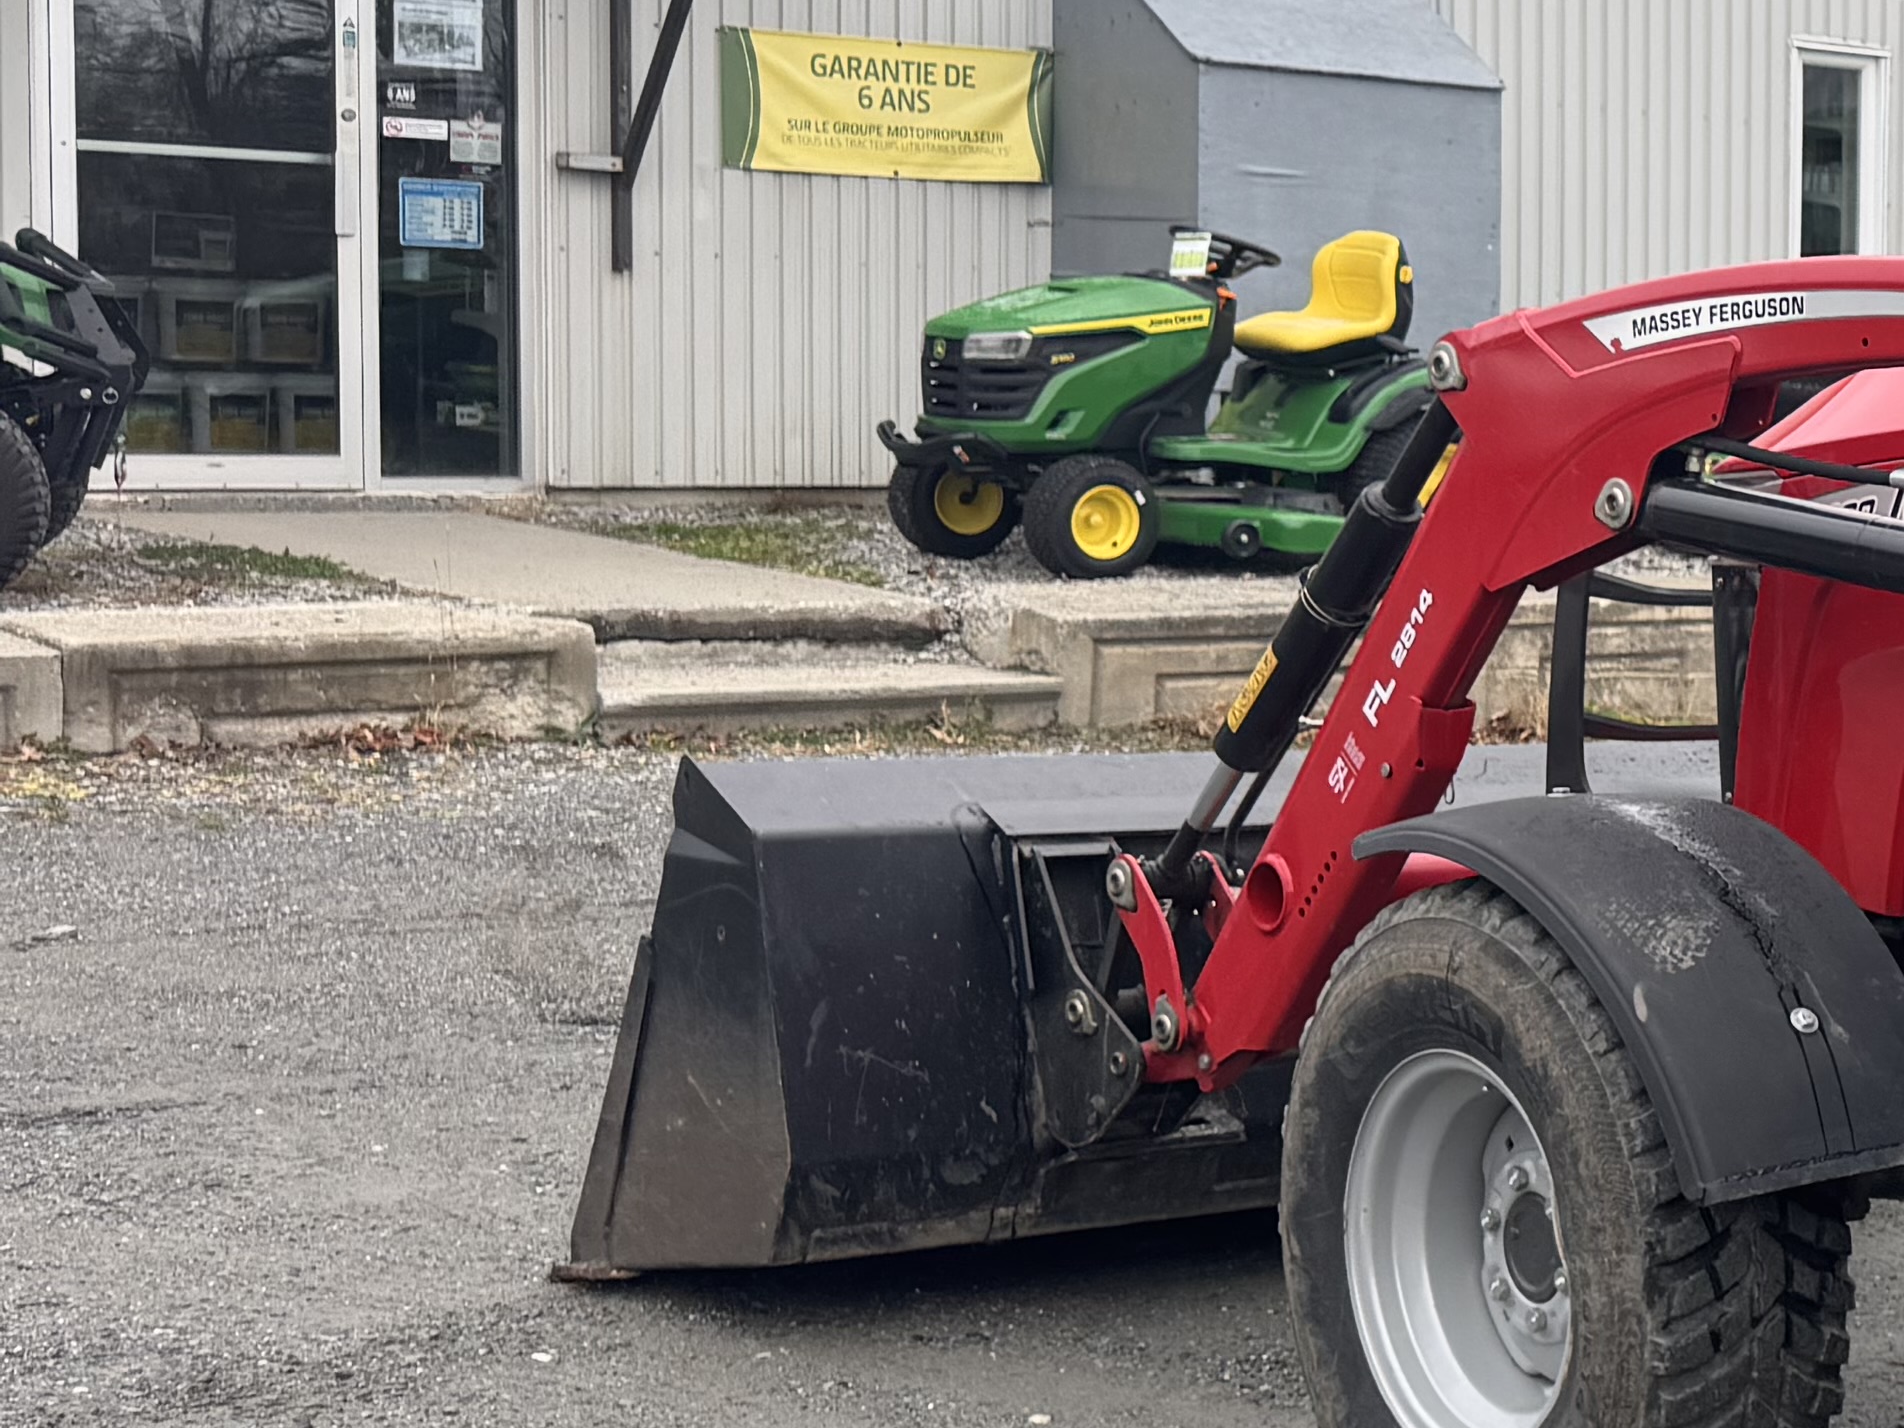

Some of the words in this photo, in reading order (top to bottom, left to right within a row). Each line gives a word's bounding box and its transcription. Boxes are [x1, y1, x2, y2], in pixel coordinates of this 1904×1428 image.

[810, 52, 937, 86] GARANTIE
[944, 63, 976, 89] DE
[858, 84, 873, 110] 6
[879, 86, 931, 114] ANS
[787, 118, 811, 133] SUR
[814, 120, 830, 135] LE
[833, 121, 883, 139] GROUPE
[887, 124, 1003, 144] MOTOPROPULSEUR
[1632, 306, 1702, 339] MASSEY
[1708, 295, 1804, 325] FERGUSON
[1361, 677, 1397, 728] FL
[1390, 587, 1434, 669] 2814
